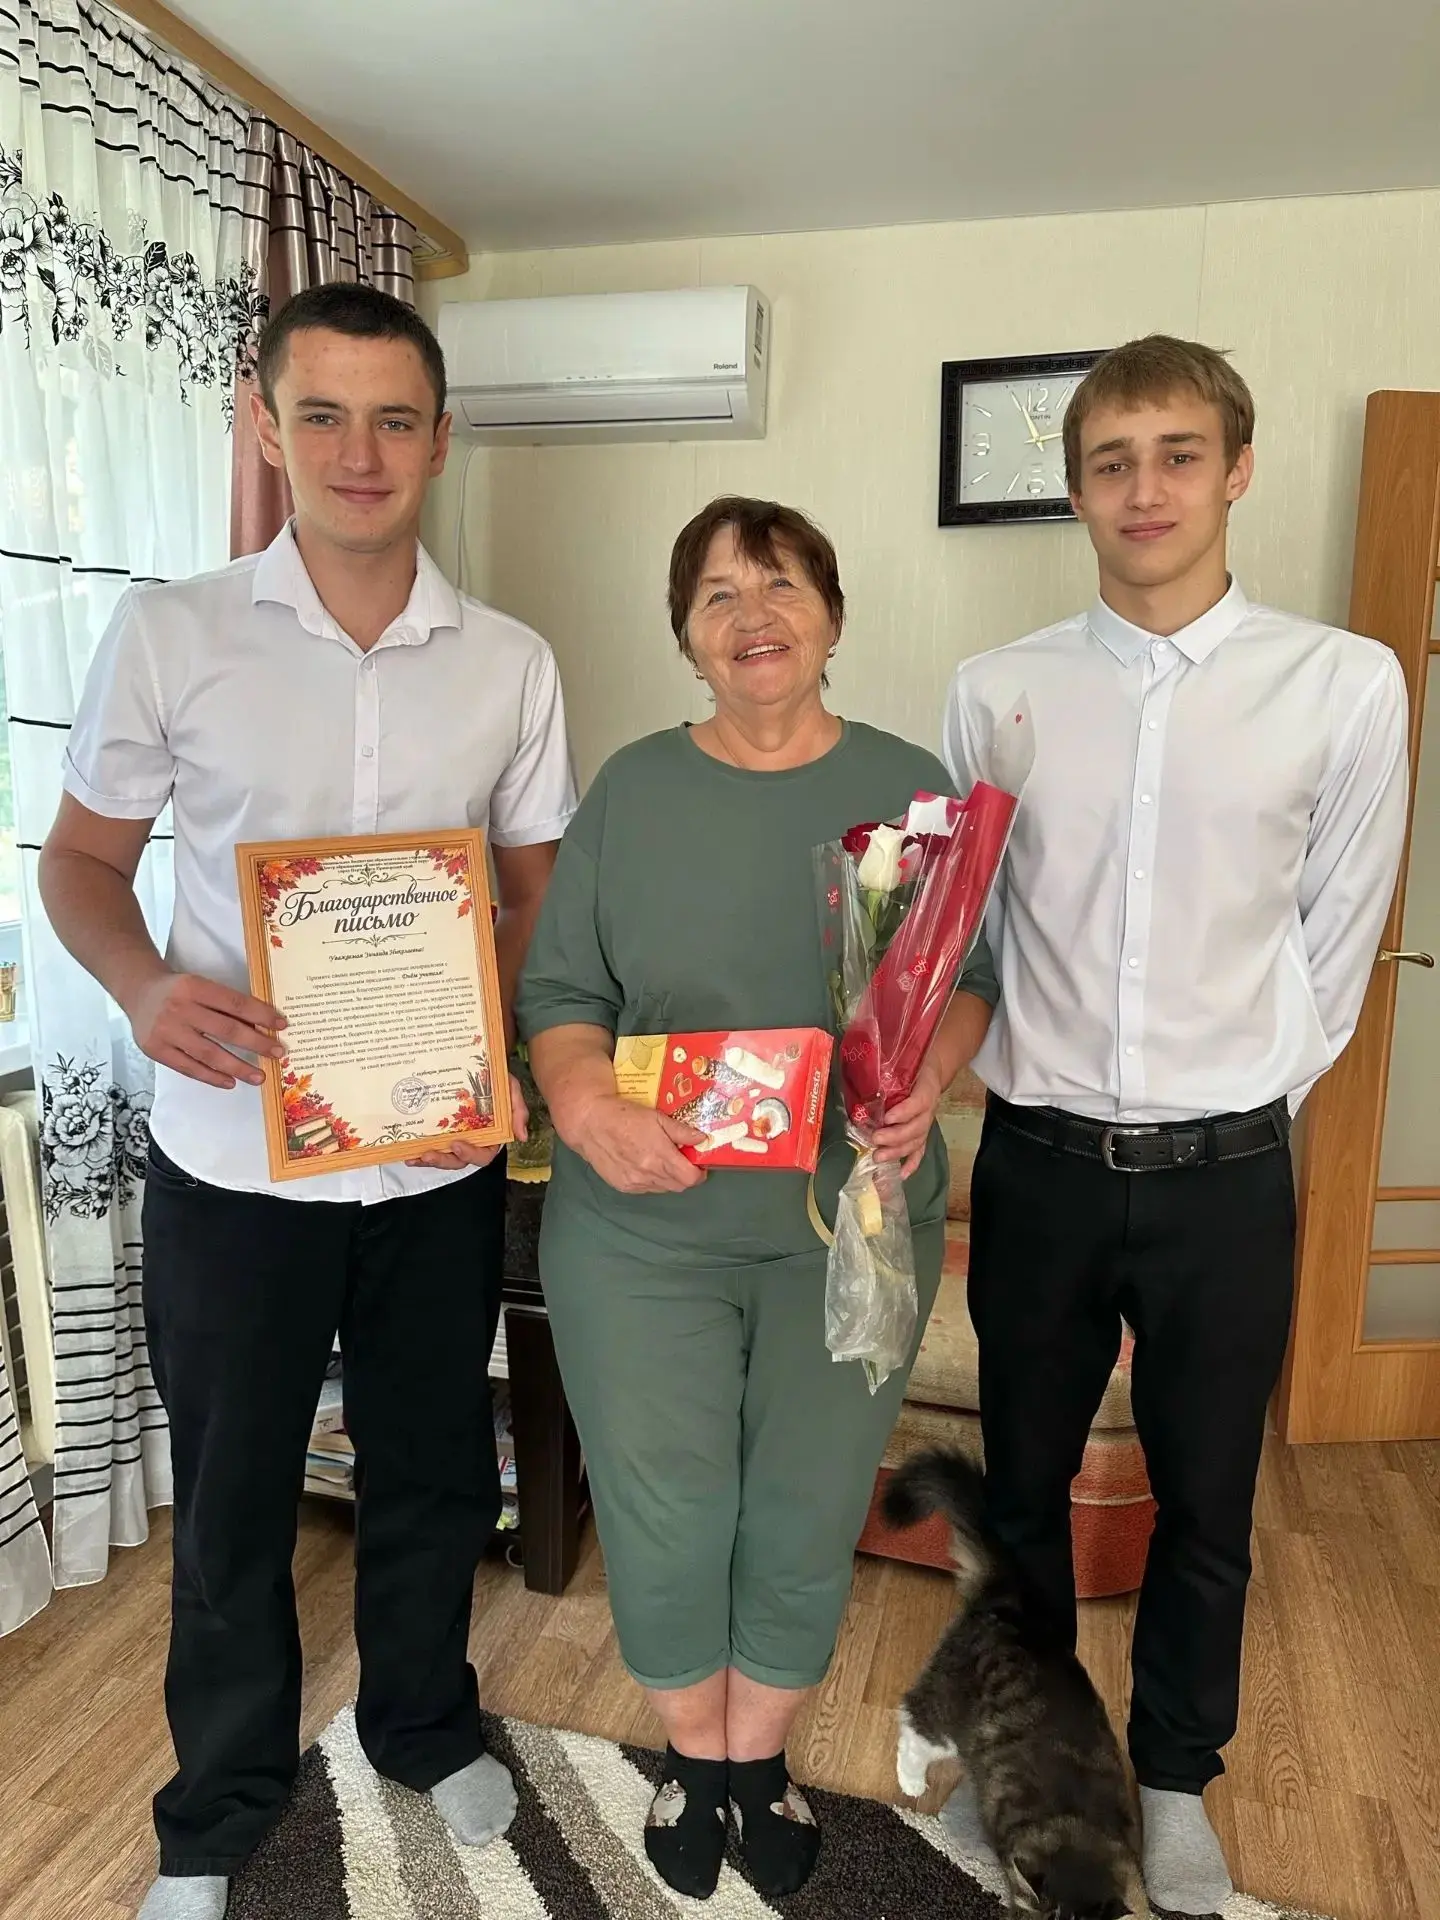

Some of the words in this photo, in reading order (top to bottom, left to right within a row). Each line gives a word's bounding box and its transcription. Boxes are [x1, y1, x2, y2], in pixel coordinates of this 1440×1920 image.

[1027, 386, 1049, 412] 12
[279, 879, 459, 929] Благодарственное
[333, 911, 419, 935] письмо
[806, 1070, 822, 1125] Konfesta
